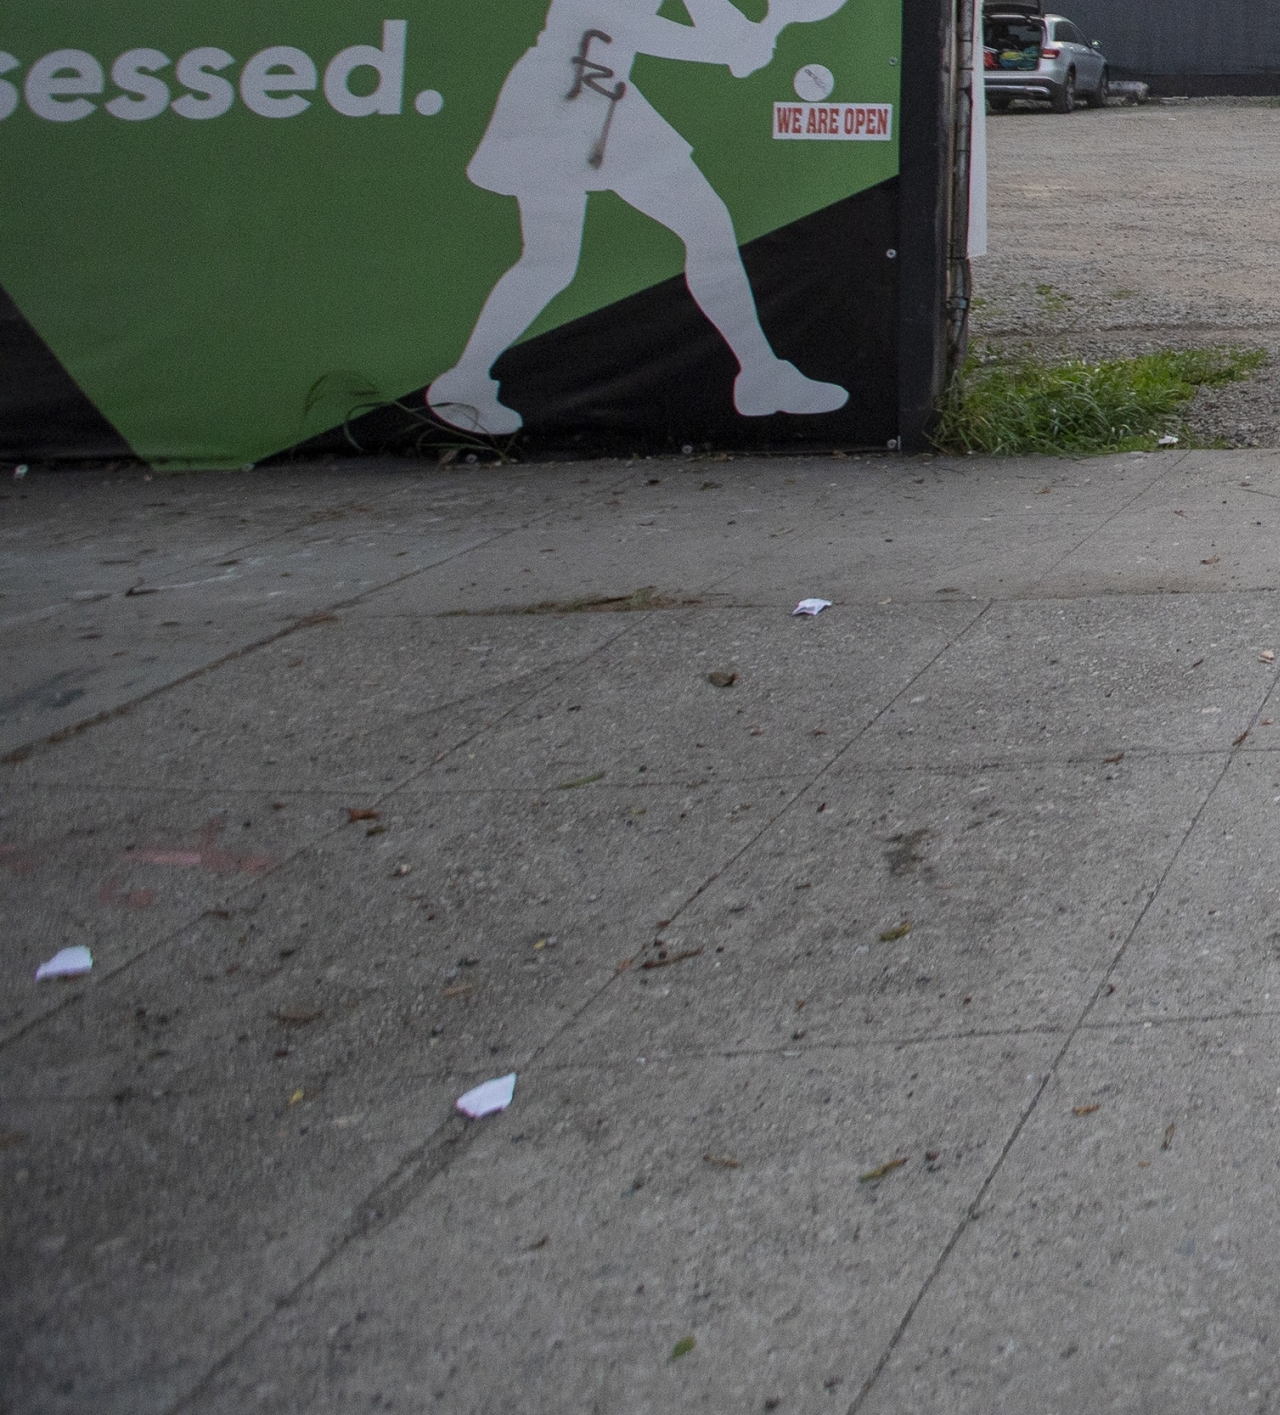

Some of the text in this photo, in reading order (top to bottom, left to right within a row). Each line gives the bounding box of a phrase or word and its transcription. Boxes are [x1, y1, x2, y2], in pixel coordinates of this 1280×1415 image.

[776, 107, 888, 135] WE ARE OPEN
